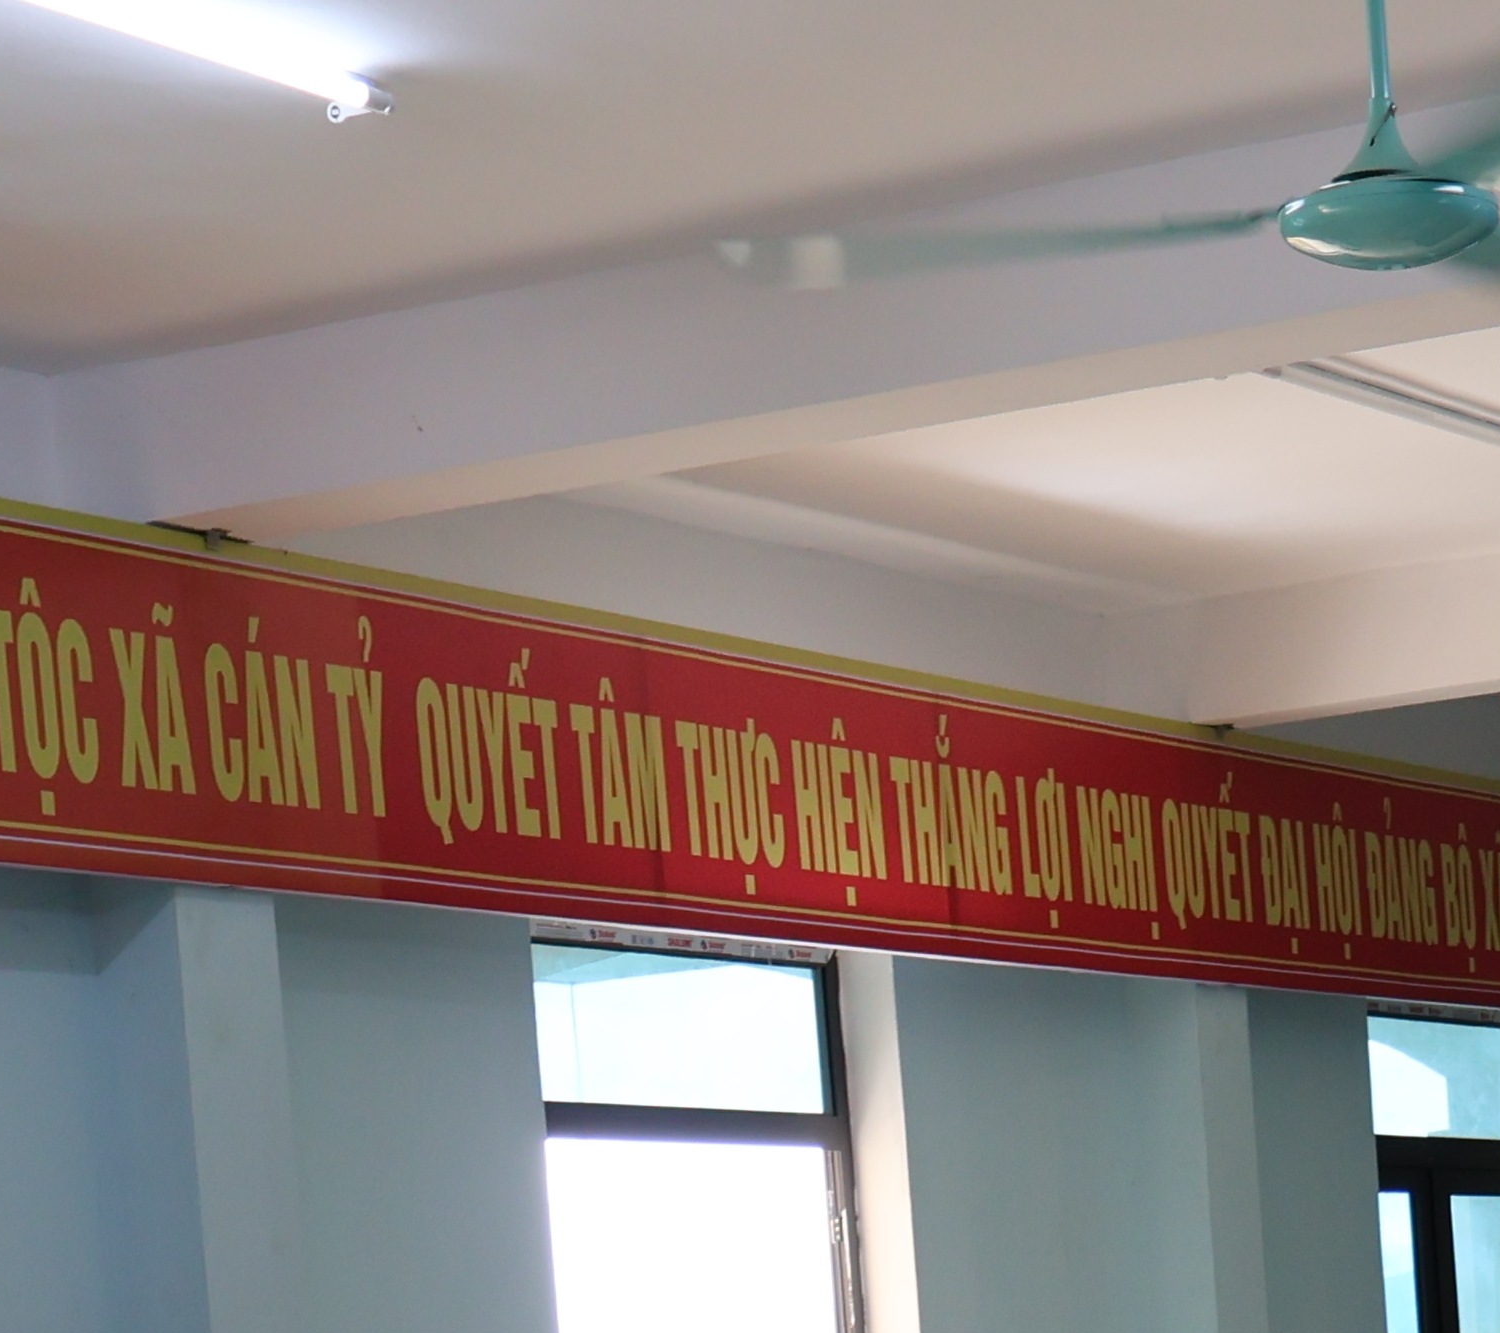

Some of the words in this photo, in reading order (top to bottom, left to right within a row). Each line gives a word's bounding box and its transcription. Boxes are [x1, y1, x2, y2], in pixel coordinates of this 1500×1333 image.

[109, 605, 196, 795] XÃ
[204, 616, 320, 808] CÁN
[325, 615, 386, 818] TỶ
[416, 648, 561, 845] QUYẾT
[570, 678, 671, 853] TÂM
[676, 718, 785, 895] THỰC
[791, 719, 887, 906] HIỆN
[890, 714, 1013, 896] THẮNG
[1015, 768, 1073, 928] LỢI
[1076, 787, 1159, 939] NGHỊ
[1161, 772, 1253, 930] QUYẾT
[1259, 816, 1309, 954] ĐẠI
[1312, 802, 1360, 960] HỘI
[1364, 797, 1438, 946] ĐẢNG
[1440, 823, 1477, 972] BỘ
